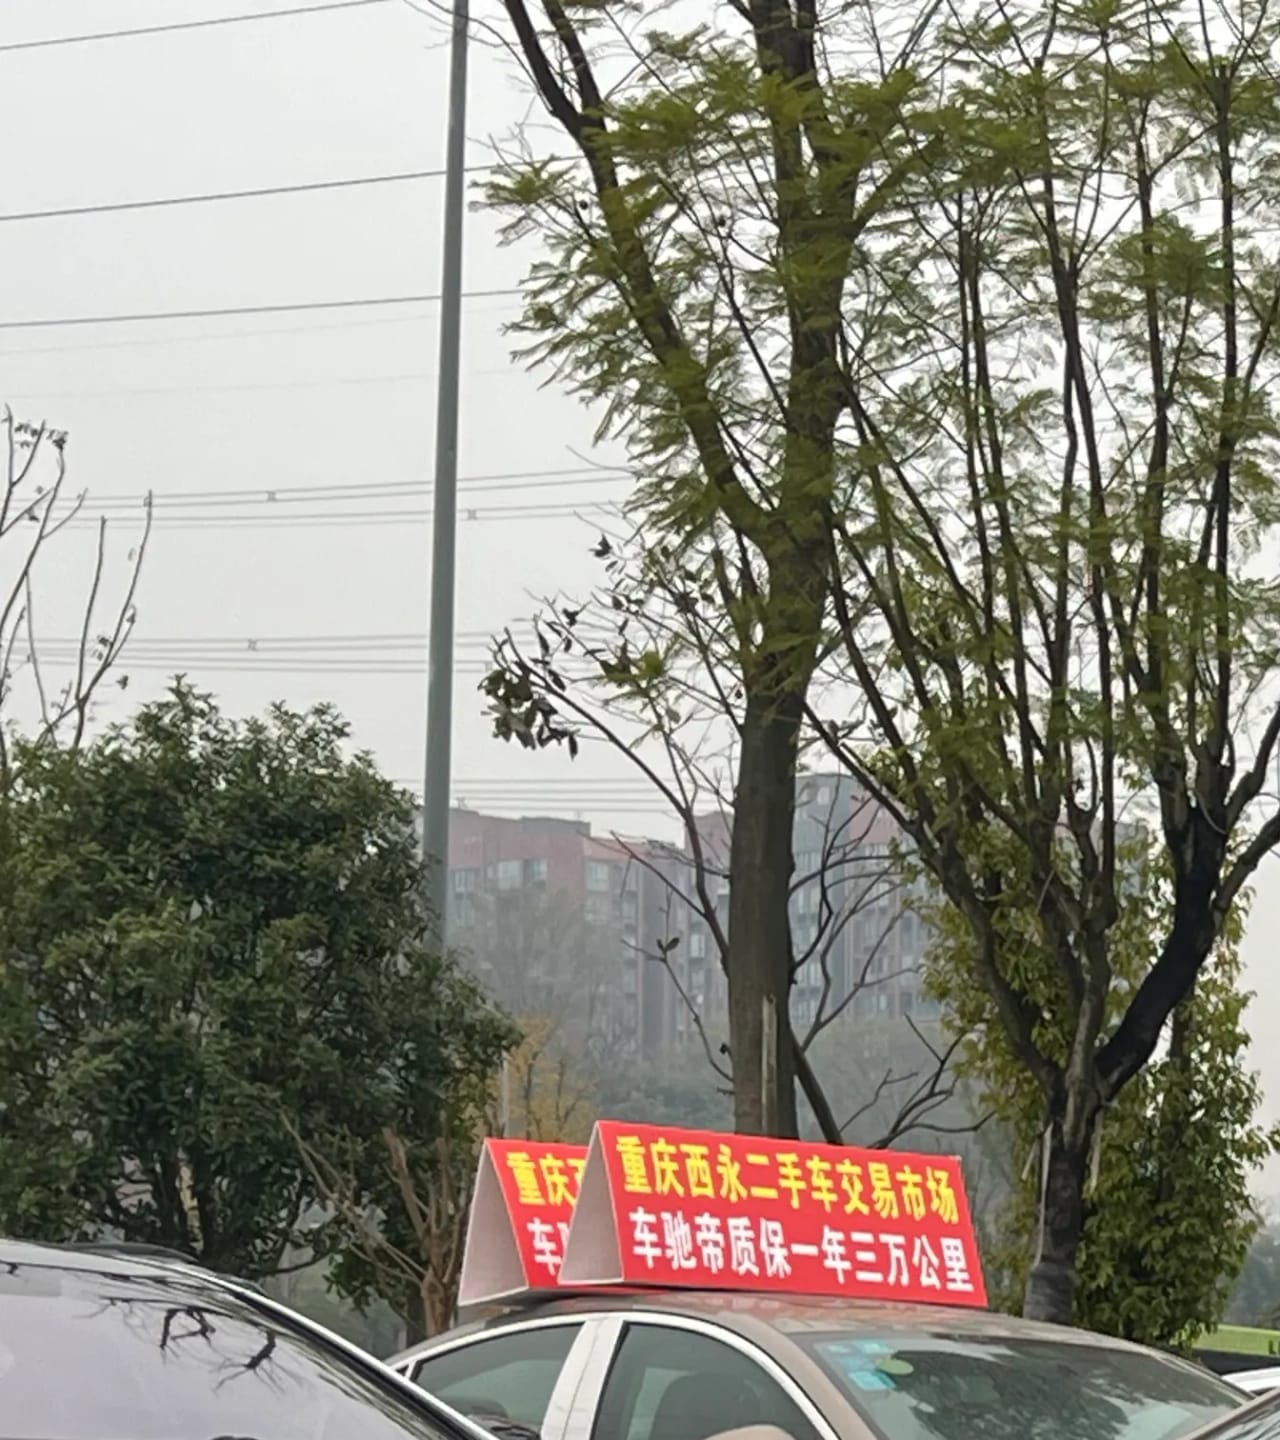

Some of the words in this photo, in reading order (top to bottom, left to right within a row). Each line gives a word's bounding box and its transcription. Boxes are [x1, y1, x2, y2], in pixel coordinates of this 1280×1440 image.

[615, 1135, 960, 1224] 重庆西永二手车交易市场
[629, 1206, 975, 1292] 车驰帝质保一年三万公里
